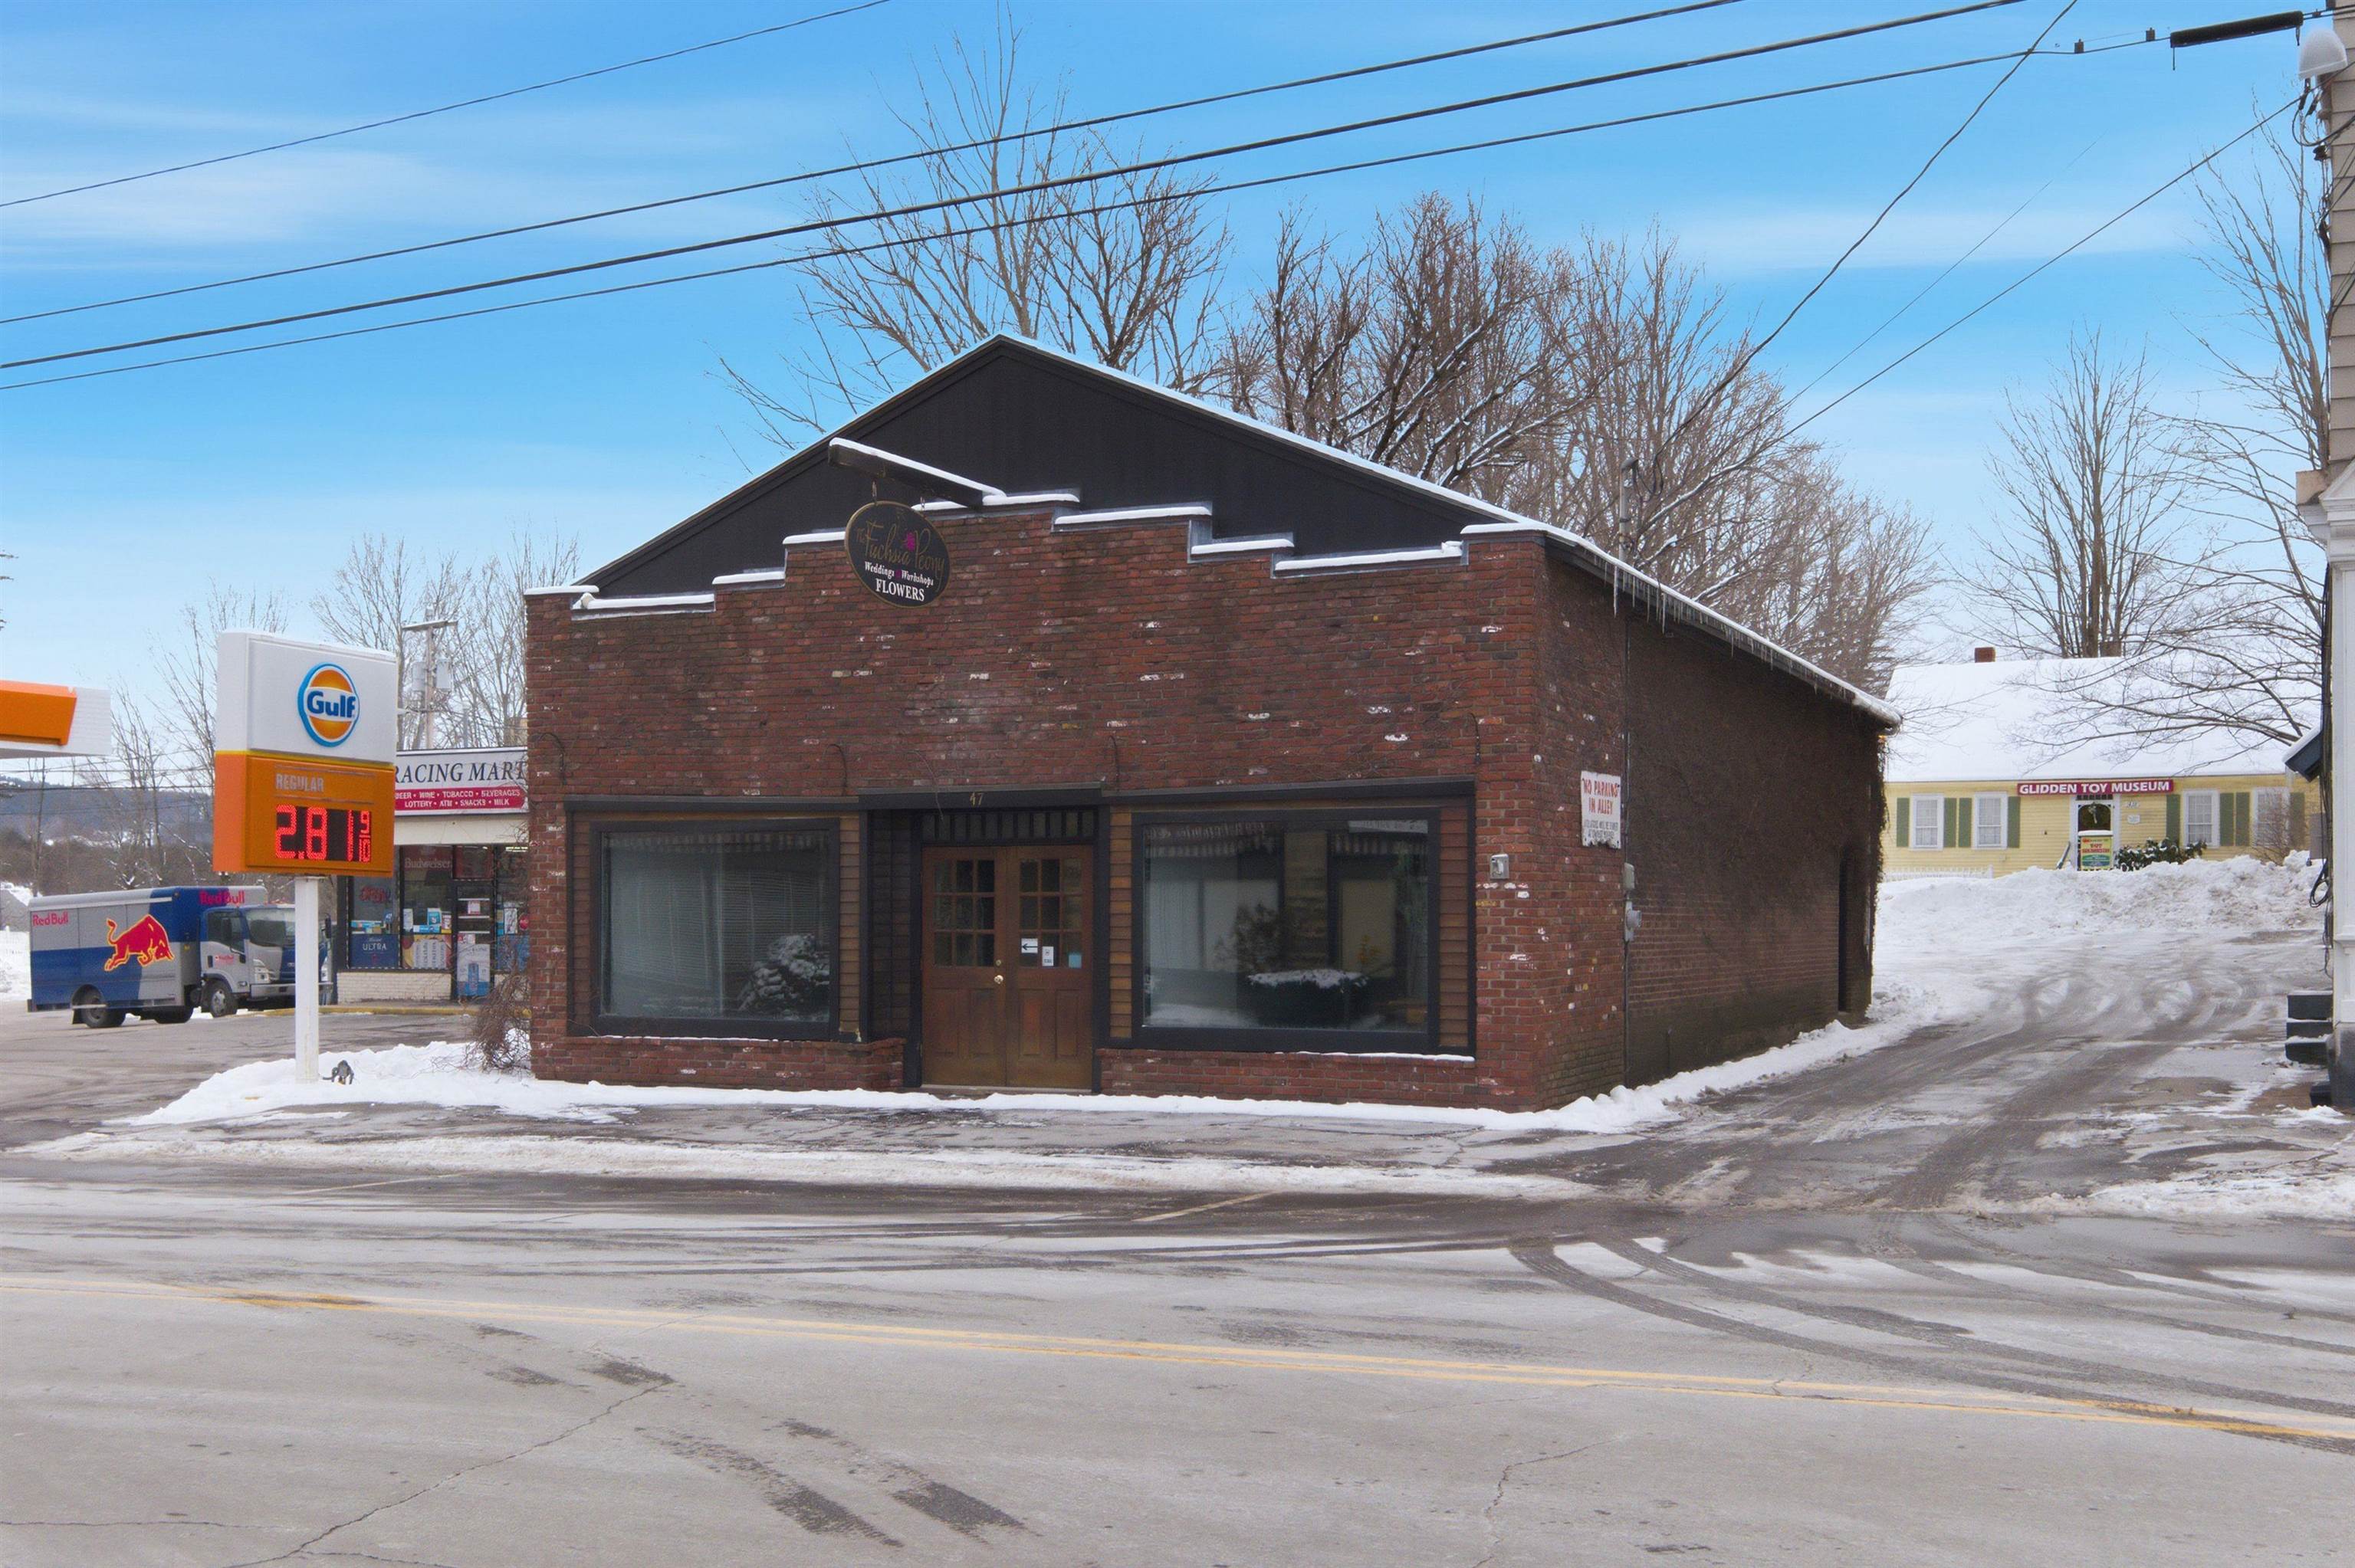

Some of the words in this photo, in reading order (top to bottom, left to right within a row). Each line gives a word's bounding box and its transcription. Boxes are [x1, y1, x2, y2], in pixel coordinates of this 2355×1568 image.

[913, 527, 944, 592] Peony
[865, 561, 895, 579] Weddings
[901, 569, 934, 588] Workshops
[875, 578, 925, 602] FLOWERS
[307, 691, 355, 718] Gulf
[468, 761, 527, 781] MART
[276, 773, 324, 792] REGULAR
[1583, 778, 1592, 795] NO
[1594, 780, 1618, 798] PARKING
[2019, 784, 2077, 794] GLIDDEN
[2081, 783, 2108, 793] TOY
[2111, 782, 2169, 792] MUSEUM
[1588, 797, 1596, 813] IN
[1598, 799, 1614, 815] ALLEY
[405, 858, 452, 869] Budweiser
[199, 891, 222, 905] Red
[225, 890, 245, 904] Bull
[32, 914, 51, 927] Red
[51, 912, 68, 925] Bull
[362, 943, 387, 951] ULTRA
